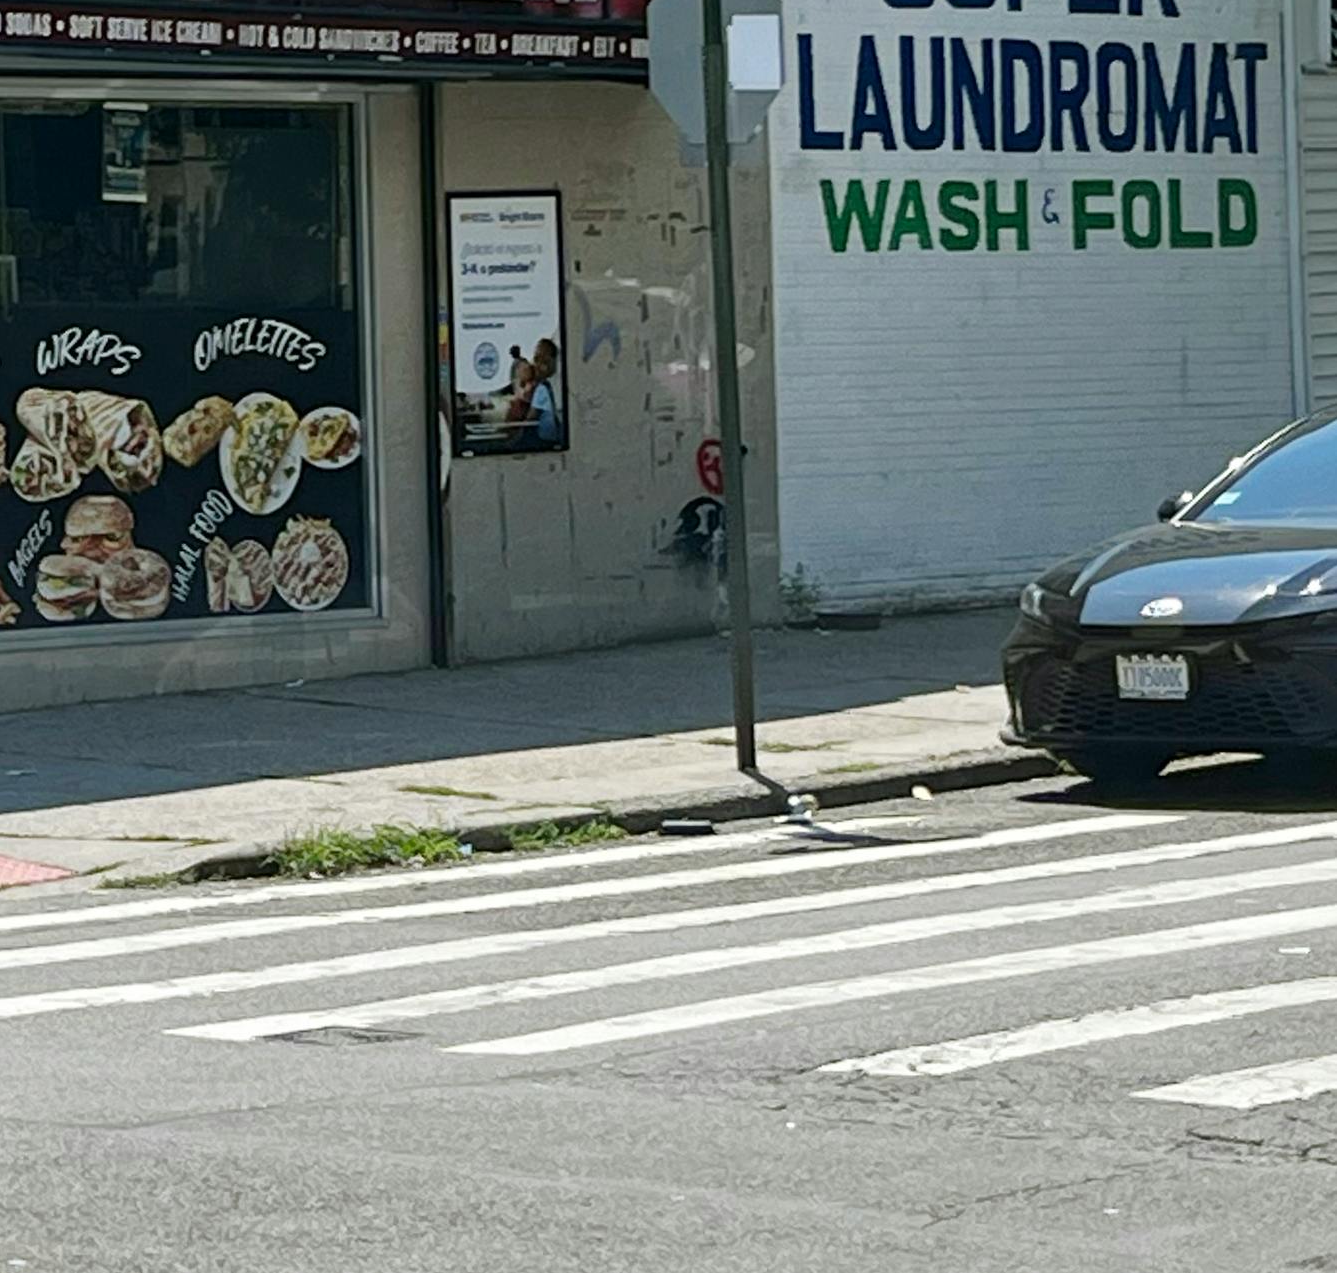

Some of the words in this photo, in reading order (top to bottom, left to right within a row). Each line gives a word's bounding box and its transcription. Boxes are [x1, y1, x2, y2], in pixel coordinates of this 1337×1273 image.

[68, 14, 104, 39] SOFT
[106, 17, 148, 42] SERVE
[150, 19, 173, 44] ICE
[175, 21, 222, 46] CREAM
[267, 25, 280, 49] &
[282, 26, 316, 50] COLD
[414, 31, 460, 55] COFFEE
[474, 33, 498, 55] TEA
[796, 32, 1269, 154] LAUNDROMAT
[819, 178, 1031, 253] WASH
[1040, 187, 1061, 225] &
[1071, 178, 1259, 251] FOLD
[36, 327, 142, 376] WRAPS
[193, 317, 327, 374] OMELETTES
[7, 507, 53, 589] BAGELS
[171, 542, 203, 603] HALAL
[188, 489, 234, 544] FOOD
